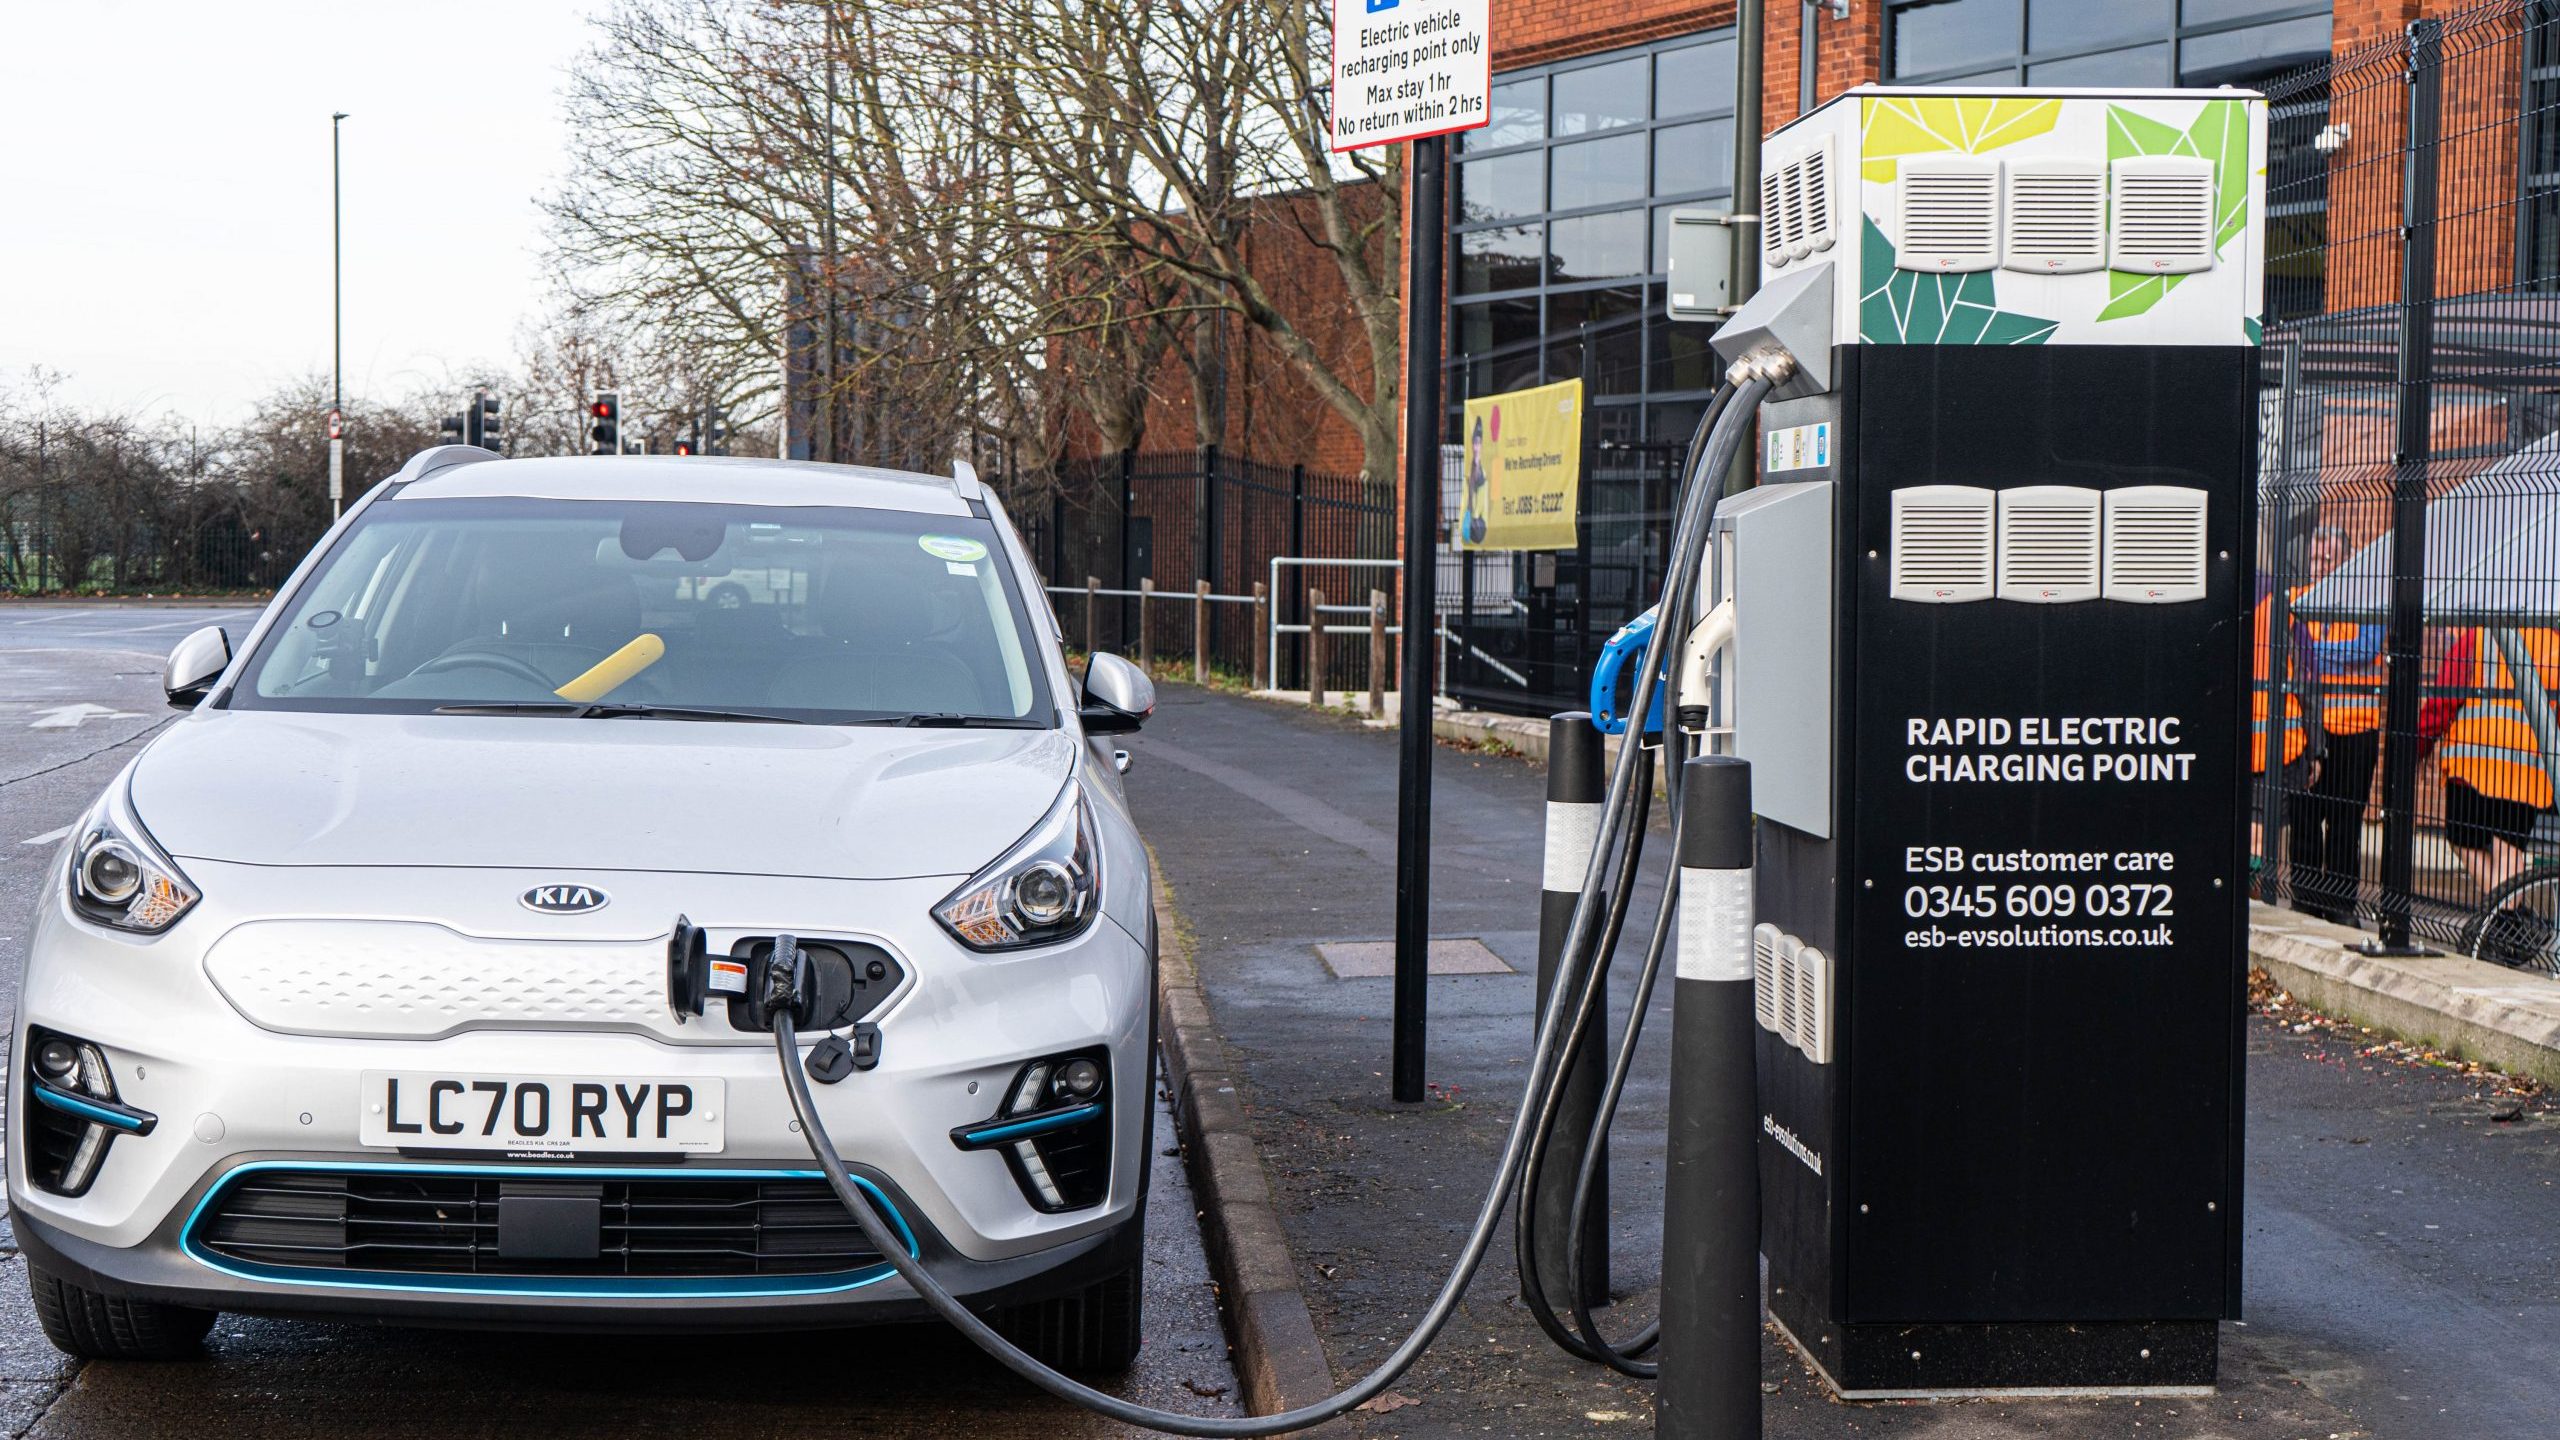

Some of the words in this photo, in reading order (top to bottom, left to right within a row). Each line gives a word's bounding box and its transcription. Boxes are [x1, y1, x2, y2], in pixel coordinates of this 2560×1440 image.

[1361, 20, 1409, 49] Electric
[1414, 9, 1461, 36] vehicle
[1341, 50, 1408, 78] recharging
[1413, 40, 1447, 66] point
[1452, 31, 1481, 54] only
[1367, 85, 1393, 105] Max
[1397, 79, 1424, 100] stay
[1429, 73, 1434, 93] 1
[1438, 74, 1452, 91] hr
[1338, 117, 1355, 136] No
[1359, 111, 1399, 133] return
[1404, 101, 1444, 124] within
[1449, 96, 1457, 116] 2
[1460, 95, 1482, 113] hrs
[1503, 496, 1515, 515] Text
[1516, 495, 1532, 514] JOBS
[1907, 717, 2012, 745] RAPID
[2019, 717, 2181, 745] ELECTRIC
[1905, 753, 2085, 782] CHARGING
[2092, 753, 2196, 781] POINT
[1905, 846, 1964, 873] ESB
[1971, 849, 2108, 872] customer
[2114, 851, 2174, 871] care
[535, 887, 594, 906] KIA
[1904, 885, 1997, 918] 0345
[2006, 885, 2076, 917] 609
[2085, 884, 2174, 917] 0372
[1904, 924, 2174, 948] esb-evsolutions.co.uk
[387, 1078, 550, 1137] LC70
[571, 1083, 693, 1139] RYP
[507, 1151, 574, 1159] www.beadles.co.uk
[1764, 1113, 1821, 1176] esb-evsolutions.co.uk
